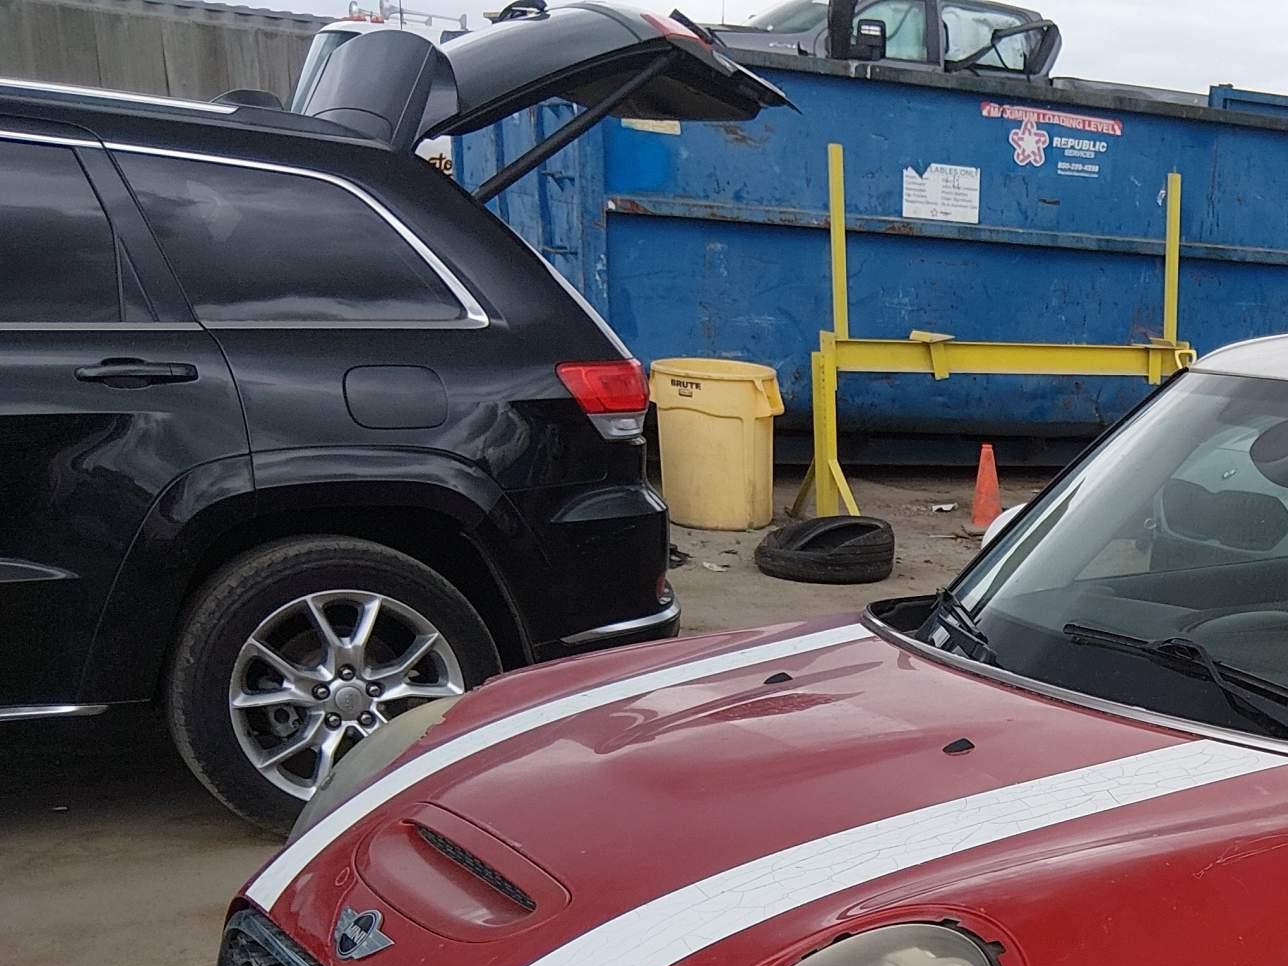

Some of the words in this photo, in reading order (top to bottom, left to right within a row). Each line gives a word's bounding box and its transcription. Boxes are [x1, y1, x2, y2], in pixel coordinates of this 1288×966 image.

[1040, 114, 1084, 128] LOADING
[1085, 120, 1114, 134] LEVEL
[1053, 137, 1108, 153] REPUBLIC
[671, 379, 702, 390] BRUTE
